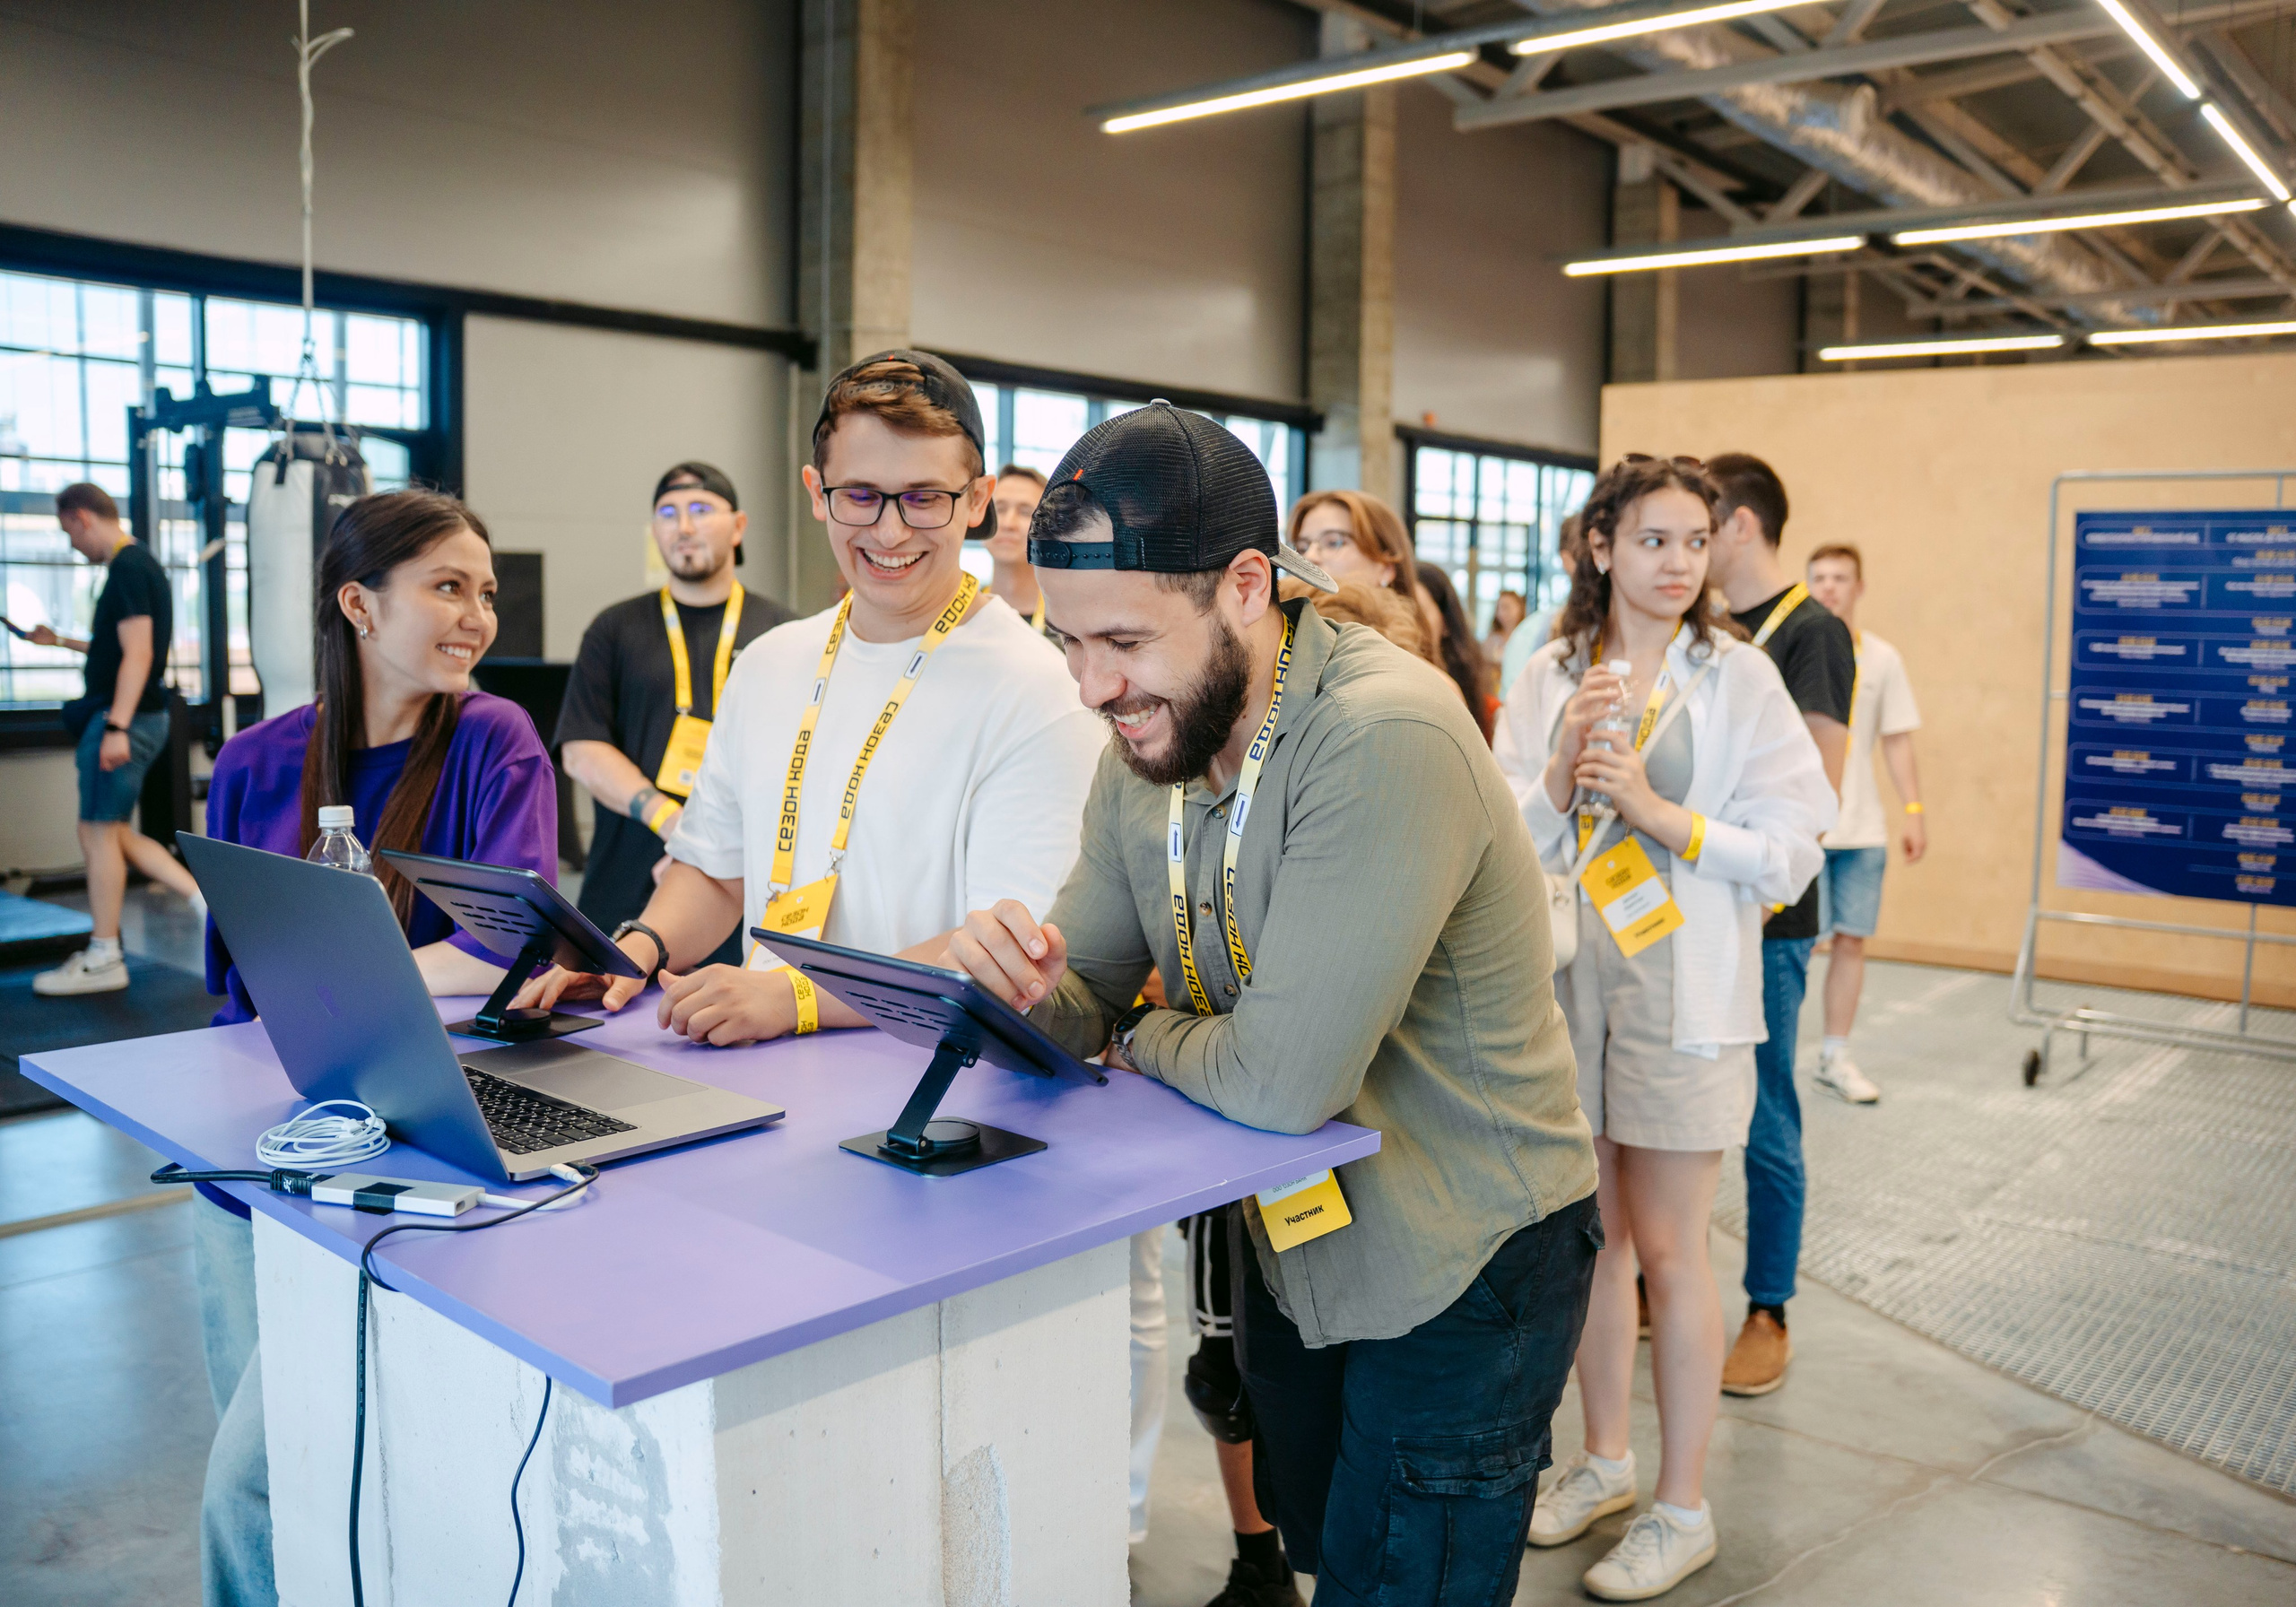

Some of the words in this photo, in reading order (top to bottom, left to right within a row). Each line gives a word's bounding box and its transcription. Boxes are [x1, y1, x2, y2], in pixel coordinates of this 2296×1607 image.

[1233, 951, 1251, 977] ко
[1184, 964, 1212, 1017] езон
[1284, 1204, 1325, 1226] Участник
